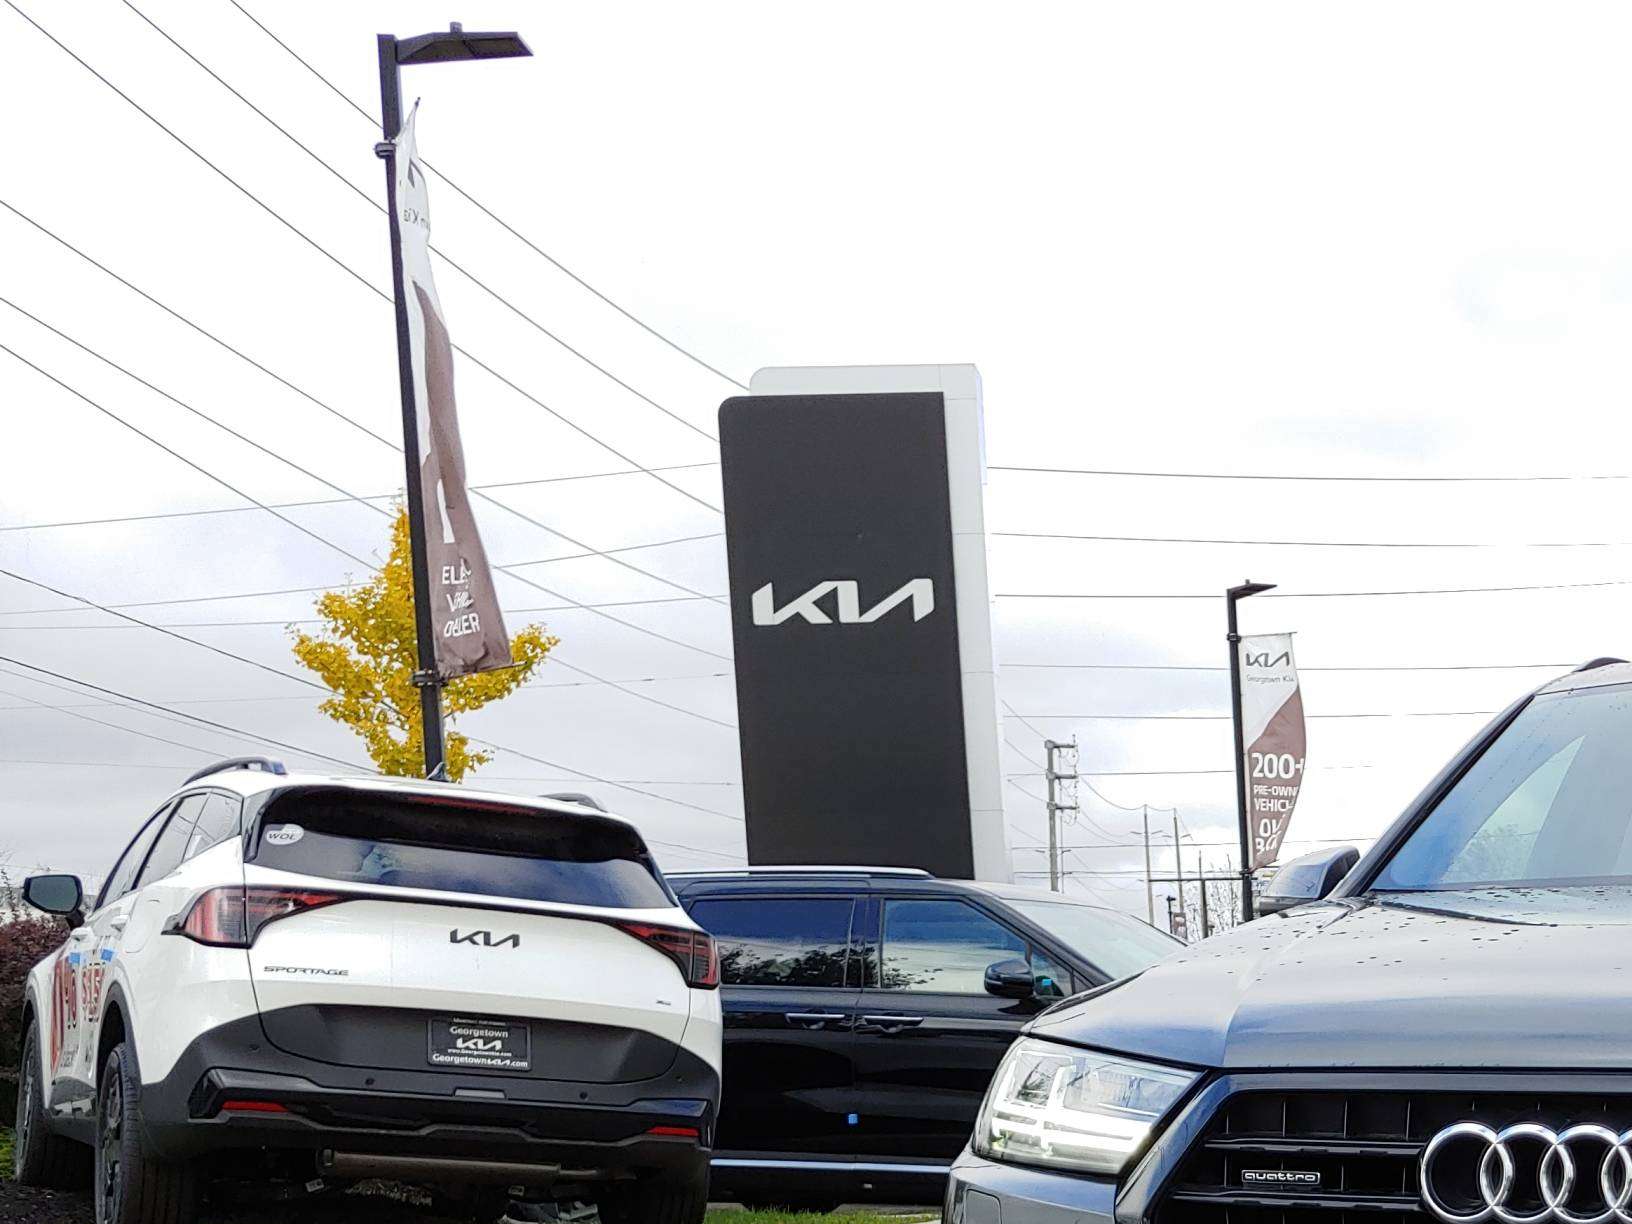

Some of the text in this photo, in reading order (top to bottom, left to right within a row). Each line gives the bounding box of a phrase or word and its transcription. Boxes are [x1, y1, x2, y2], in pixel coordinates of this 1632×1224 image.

[752, 578, 935, 626] KIA
[449, 928, 520, 949] KIA
[263, 966, 349, 976] SPORTAGE
[1244, 1172, 1316, 1182] quattro
